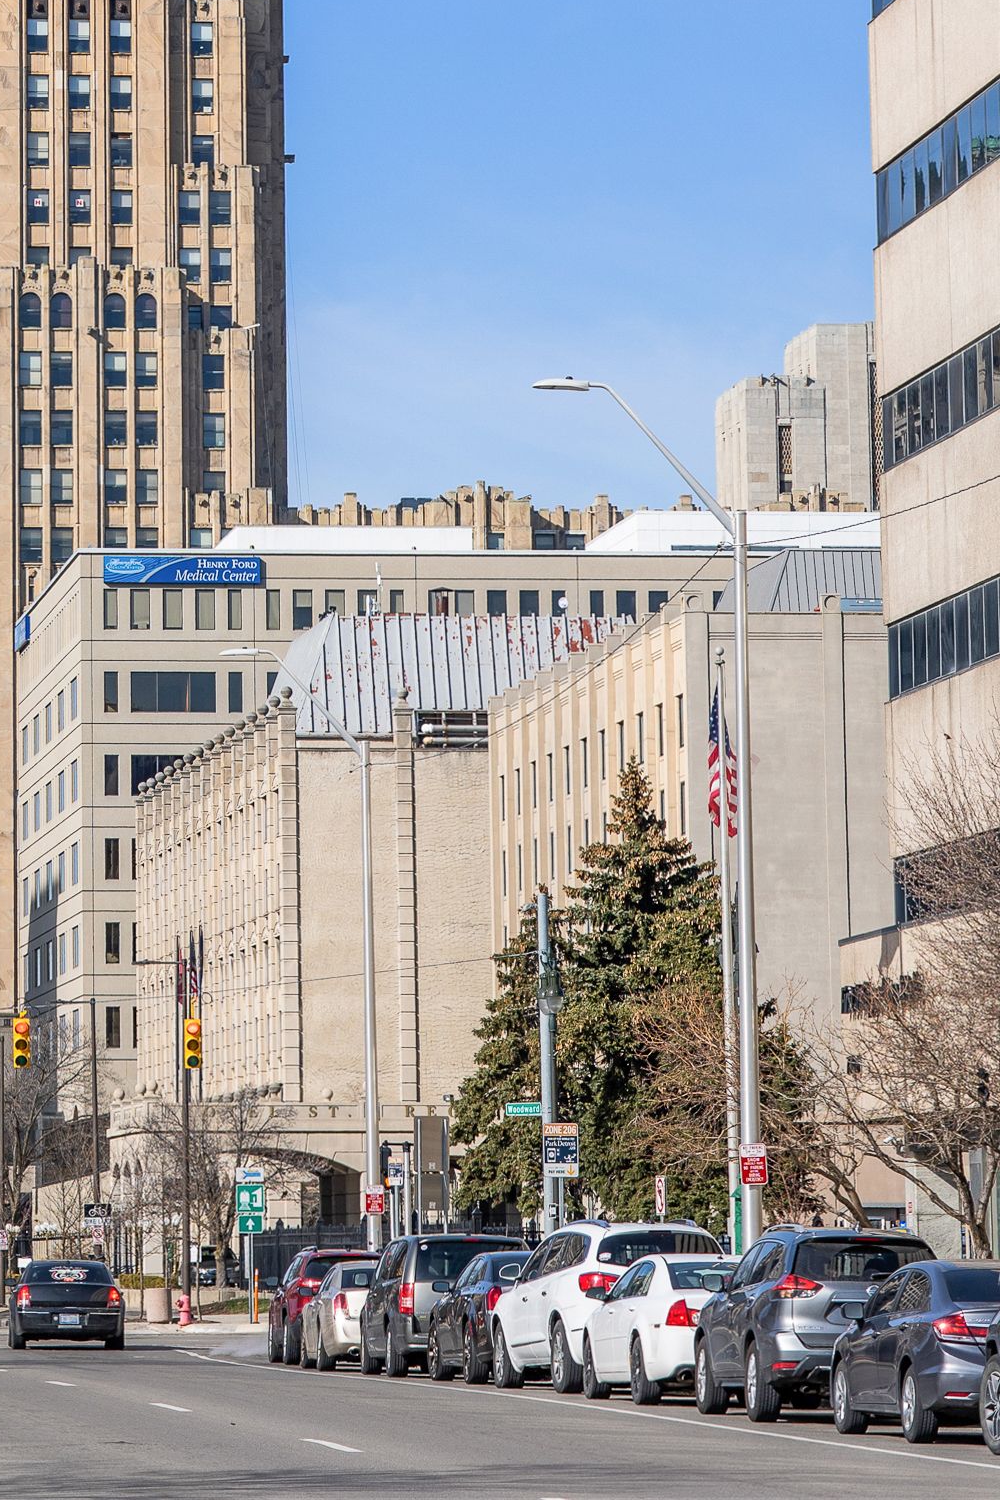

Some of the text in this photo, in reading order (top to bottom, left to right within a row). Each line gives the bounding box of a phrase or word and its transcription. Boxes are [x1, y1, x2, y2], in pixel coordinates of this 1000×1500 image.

[197, 559, 257, 569] HENRY FORD
[175, 569, 258, 581] Medical Center
[507, 1105, 540, 1113] Woodward
[544, 1125, 577, 1134] ZONE 206
